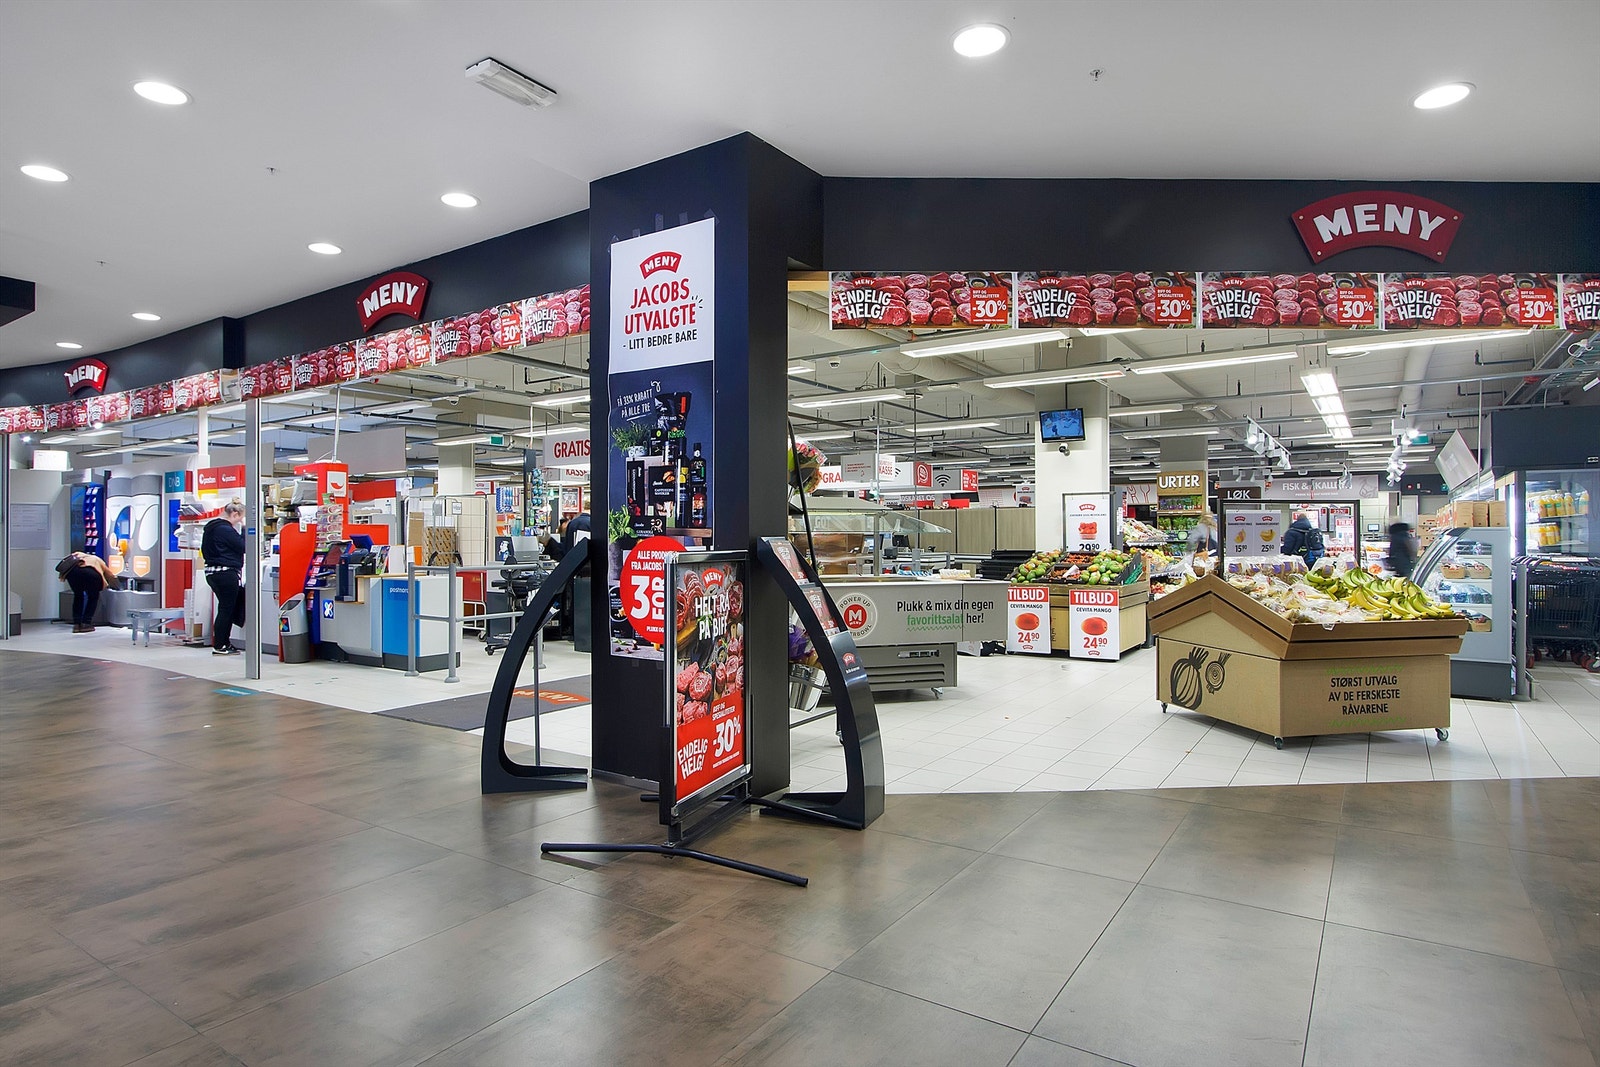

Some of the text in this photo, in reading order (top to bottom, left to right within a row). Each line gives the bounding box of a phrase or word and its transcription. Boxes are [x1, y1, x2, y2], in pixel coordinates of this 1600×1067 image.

[1313, 204, 1446, 243] MENY
[644, 256, 677, 273] MENY
[362, 282, 419, 318] MENY
[631, 278, 690, 310] JACOBS
[839, 290, 892, 306] ENDELIG
[1024, 289, 1077, 305] ENDELIG
[1208, 289, 1261, 305] ENDELIG
[1390, 290, 1442, 306] ENDELIG
[845, 303, 886, 320] HELG!
[972, 300, 1007, 318] -30%
[1031, 302, 1072, 319] HELG!
[1157, 300, 1190, 317] -30%
[1216, 303, 1255, 320] HELG!
[1339, 301, 1373, 318] -30%
[1397, 304, 1437, 320] HELG!
[1521, 301, 1553, 318] -30%
[1574, 306, 1600, 321] HEL
[529, 309, 558, 326] ENDELIG
[624, 303, 696, 335] UTVALGTE
[531, 321, 555, 336] HELG!
[629, 338, 644, 350] LITT
[647, 334, 672, 347] BEDRE
[676, 329, 697, 343] BARE
[68, 365, 102, 388] MENY
[623, 394, 634, 406] 33%
[634, 389, 652, 403] RABATT
[622, 403, 651, 418] PÅ ALLE TRE
[554, 439, 590, 458] GRATIS
[168, 476, 180, 487] DNB
[1158, 475, 1200, 488] URTER
[1282, 482, 1300, 490] FISK
[1227, 490, 1250, 500] LØK
[637, 551, 650, 559] ALLE
[631, 562, 662, 570] FRA JACOBS
[704, 572, 722, 584] MENY
[631, 575, 650, 619] 3
[840, 596, 871, 609] POWER UP
[1008, 589, 1045, 600] TILBUD
[1074, 591, 1114, 604] TILBUD
[695, 594, 718, 617] HELT
[897, 600, 994, 612] Plukk & mix din egen
[848, 610, 862, 621] M
[907, 613, 984, 625] favorittsalat her!
[713, 616, 727, 638] BIFF
[1018, 632, 1031, 643] 24
[1083, 637, 1098, 649] 24
[1331, 675, 1397, 688] STØRST UTVALG
[1328, 689, 1400, 702] AV DE FERSKESTE
[1342, 703, 1388, 715] RÅVARENE
[713, 715, 741, 757] -30%
[677, 738, 708, 765] ENDELIG
[681, 754, 705, 780] HELG!
